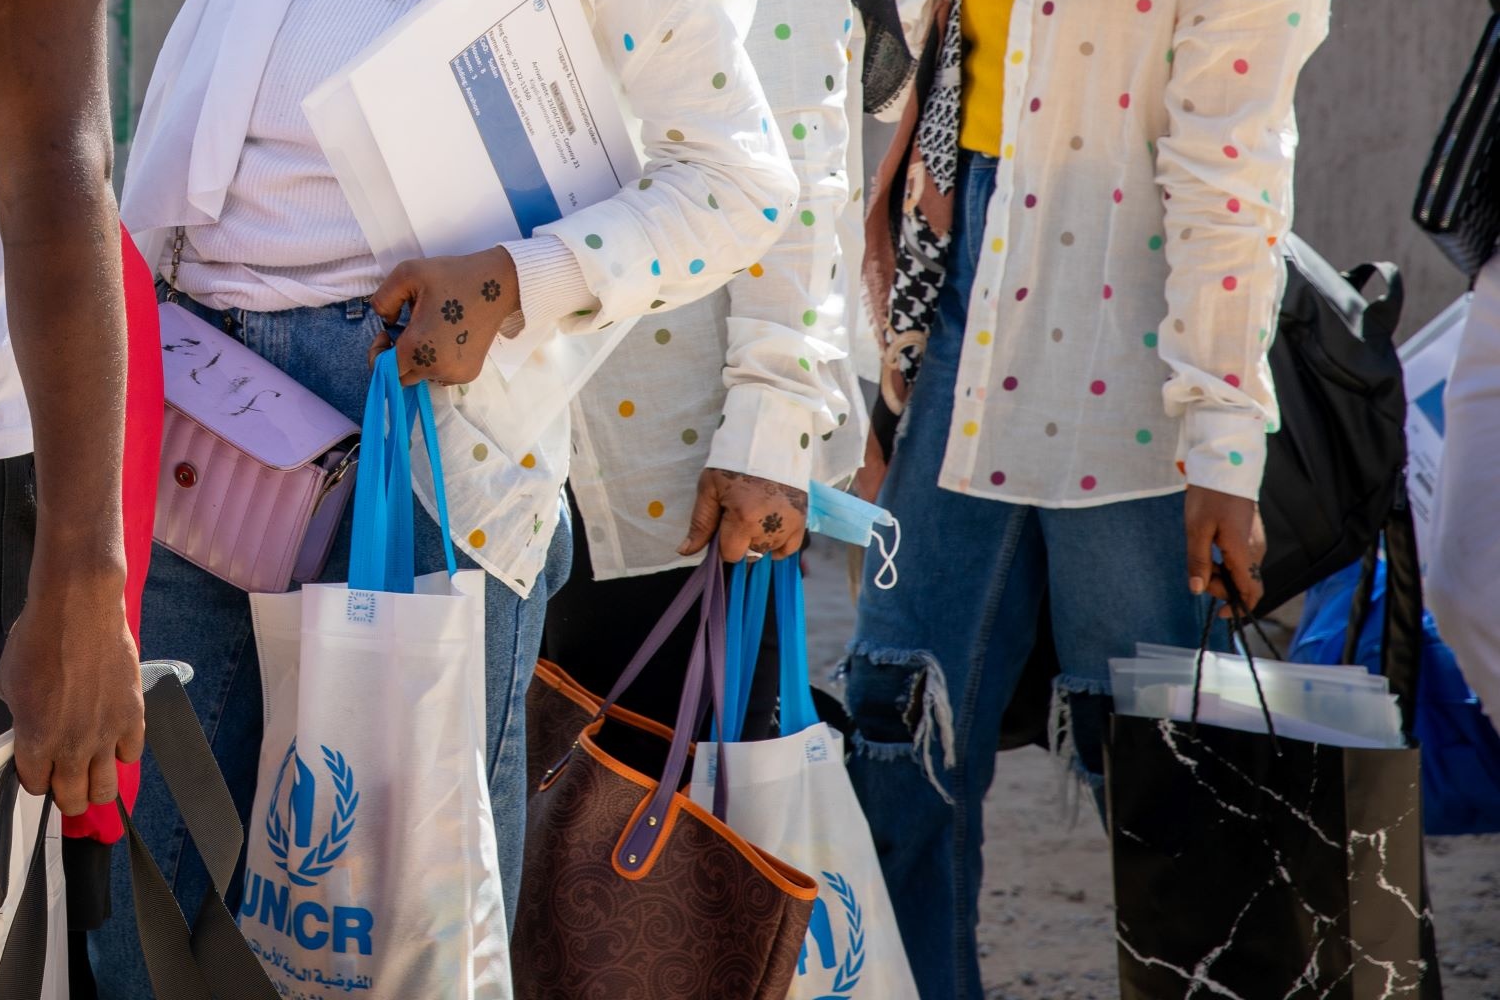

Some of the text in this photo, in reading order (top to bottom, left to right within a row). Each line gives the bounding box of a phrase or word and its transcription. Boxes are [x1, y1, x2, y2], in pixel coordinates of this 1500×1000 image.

[489, 30, 500, 52] Names:
[453, 58, 469, 88] Building:
[463, 51, 474, 74] Room:
[488, 57, 499, 79] Sudan
[532, 60, 543, 82] Arrival
[540, 81, 550, 98] date:
[563, 138, 575, 160] Convoy
[557, 47, 570, 72] Luggage
[569, 78, 591, 127] Accommodation
[588, 127, 598, 146] token
[242, 868, 373, 955] UNCR
